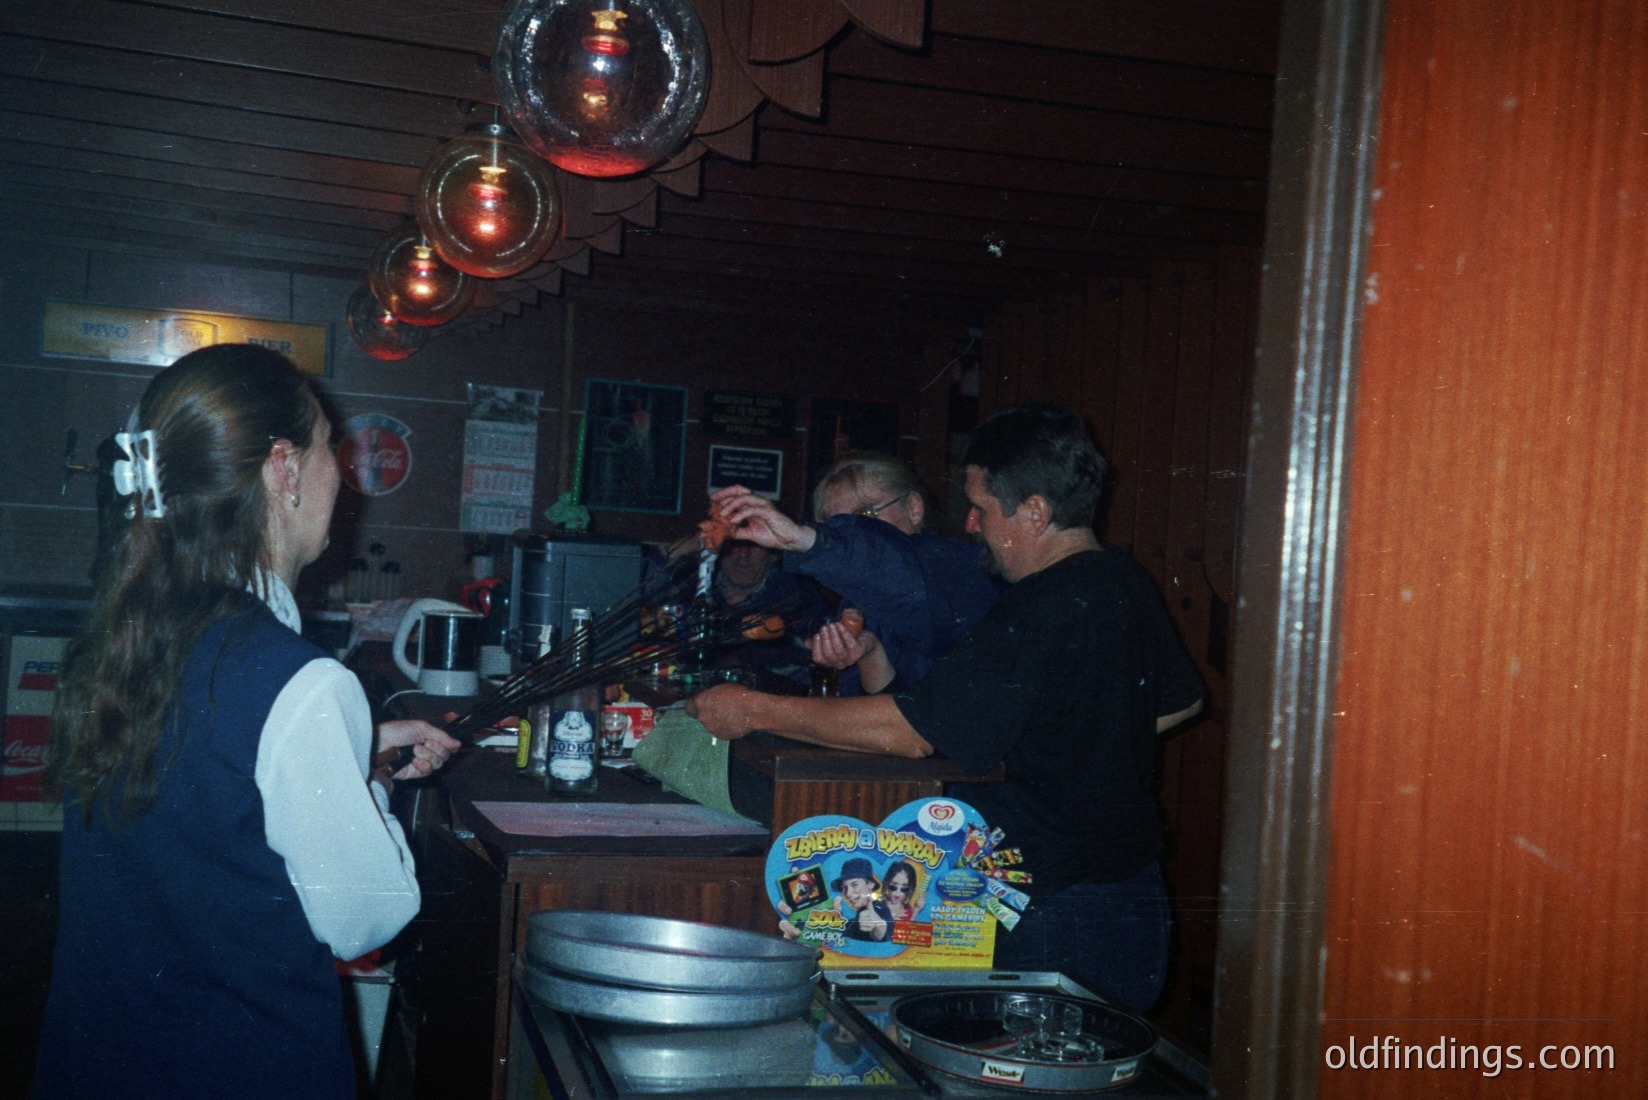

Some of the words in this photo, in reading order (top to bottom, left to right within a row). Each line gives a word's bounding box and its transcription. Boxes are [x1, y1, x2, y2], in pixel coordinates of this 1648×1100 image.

[83, 322, 129, 339] PIVO
[24, 660, 61, 673] PEP
[640, 709, 653, 718] 30
[928, 821, 953, 833] Algida
[786, 826, 857, 860] ZBIERAJ
[859, 829, 874, 848] a
[877, 829, 944, 868] VYHRAJ
[806, 909, 847, 931] 500x
[803, 931, 826, 942] GAME
[827, 932, 843, 943] BOY
[987, 1065, 1020, 1078] West
